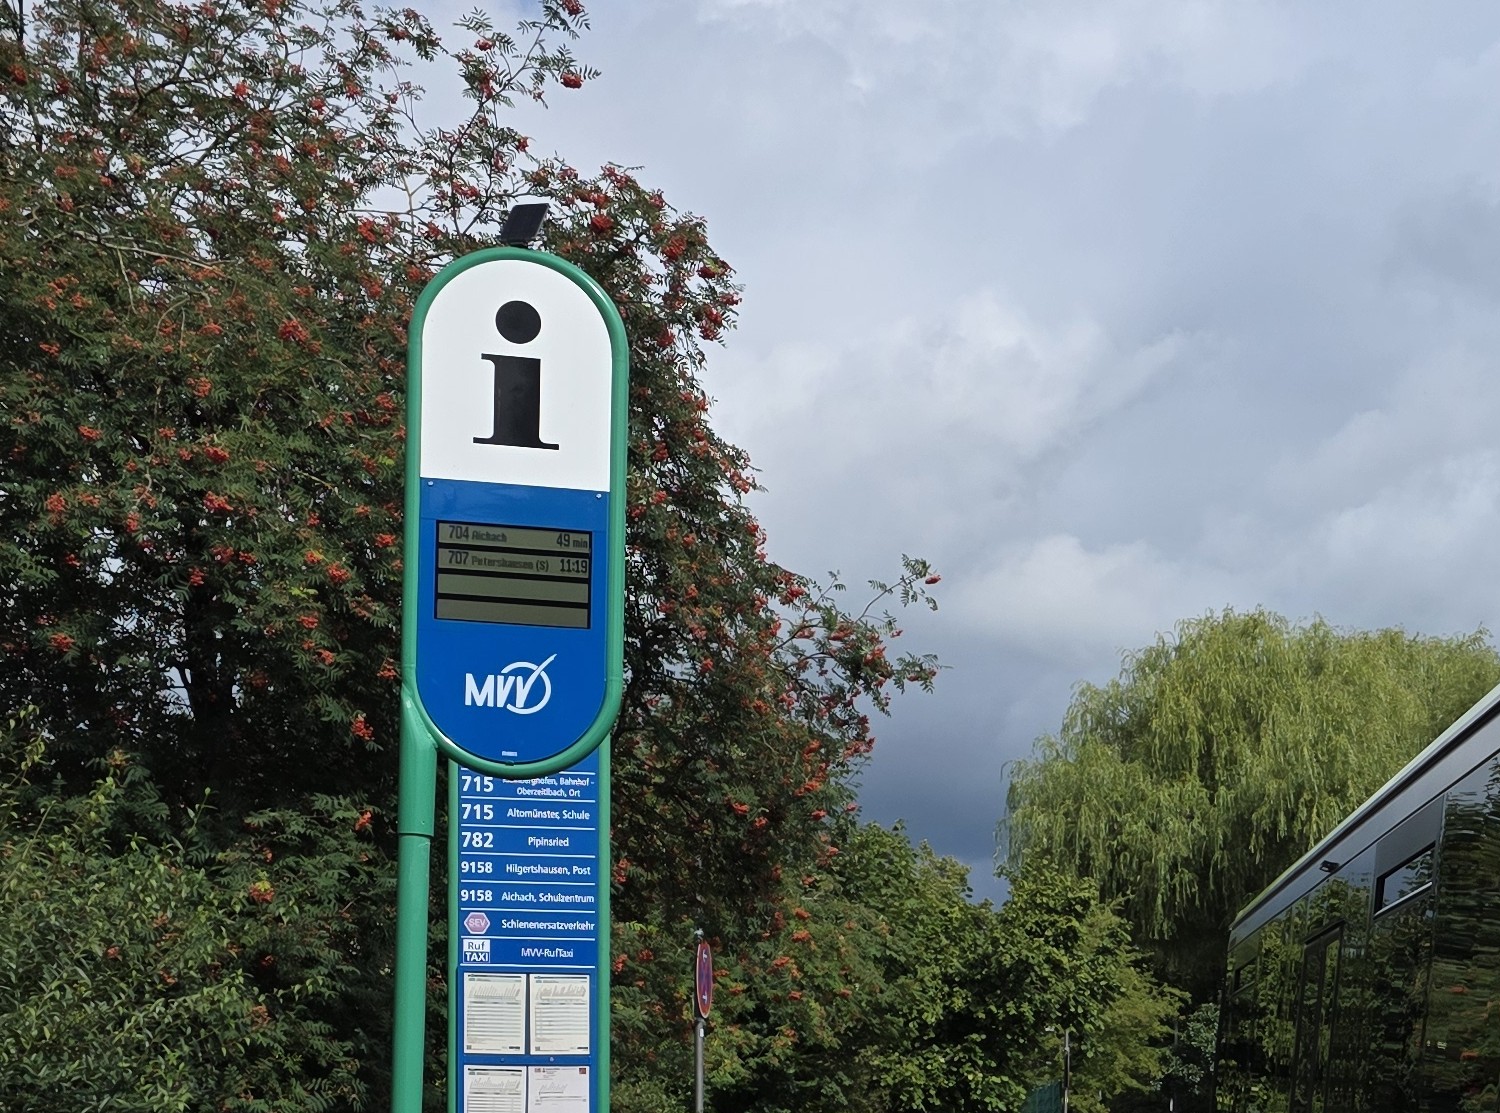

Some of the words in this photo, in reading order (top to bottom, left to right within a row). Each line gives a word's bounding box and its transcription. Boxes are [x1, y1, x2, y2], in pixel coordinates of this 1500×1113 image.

[473, 300, 560, 451] i
[449, 525, 470, 541] 704
[471, 530, 507, 543] Aichach
[556, 533, 571, 548] 49
[573, 538, 588, 549] min
[448, 550, 469, 565] 707
[536, 559, 550, 573] (S)
[560, 558, 588, 574] 11:19
[464, 653, 557, 710] MVV
[461, 775, 494, 792] 715
[559, 777, 590, 787] Bahnhof
[568, 788, 581, 798] Ort
[461, 803, 494, 820] 715
[506, 808, 560, 820] Altomünster,
[562, 809, 591, 820] Schule
[461, 831, 494, 848] 782
[528, 836, 569, 848] Pipinsried
[461, 861, 493, 874] 9158
[505, 863, 571, 876] Hilgertshausen,
[572, 865, 591, 876] Post
[460, 889, 493, 902] 9158
[501, 891, 537, 903] Aichach,
[538, 892, 595, 903] Schulzentrum
[468, 918, 486, 927] SEV
[501, 918, 596, 931] Schienenersatzverkehr
[467, 941, 486, 951] Ruf
[465, 952, 489, 963] TAXI
[521, 947, 574, 958] MVV-RufTaxi
